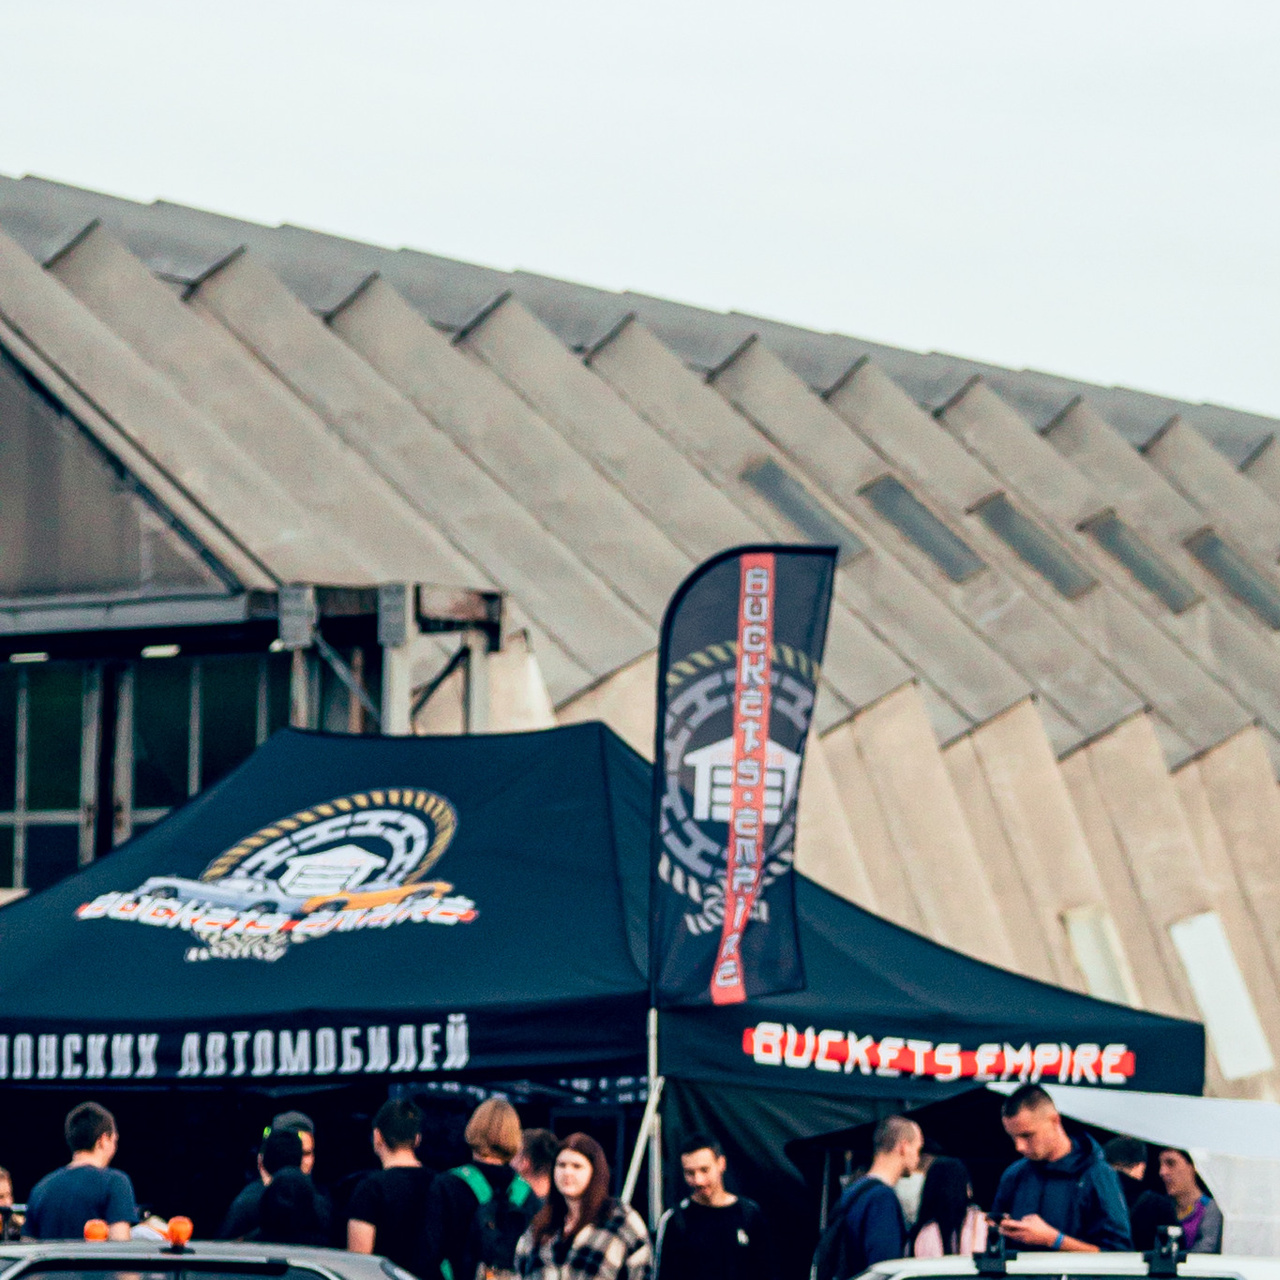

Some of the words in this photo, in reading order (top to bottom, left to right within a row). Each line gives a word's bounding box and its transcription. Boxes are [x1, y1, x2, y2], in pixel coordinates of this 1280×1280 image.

[735, 566, 770, 788] BUCKETS
[177, 1013, 469, 1078] АВТОМОБИЛЕЙ
[752, 1021, 963, 1082] BUCKETS
[974, 1041, 1128, 1084] EMPIRE
